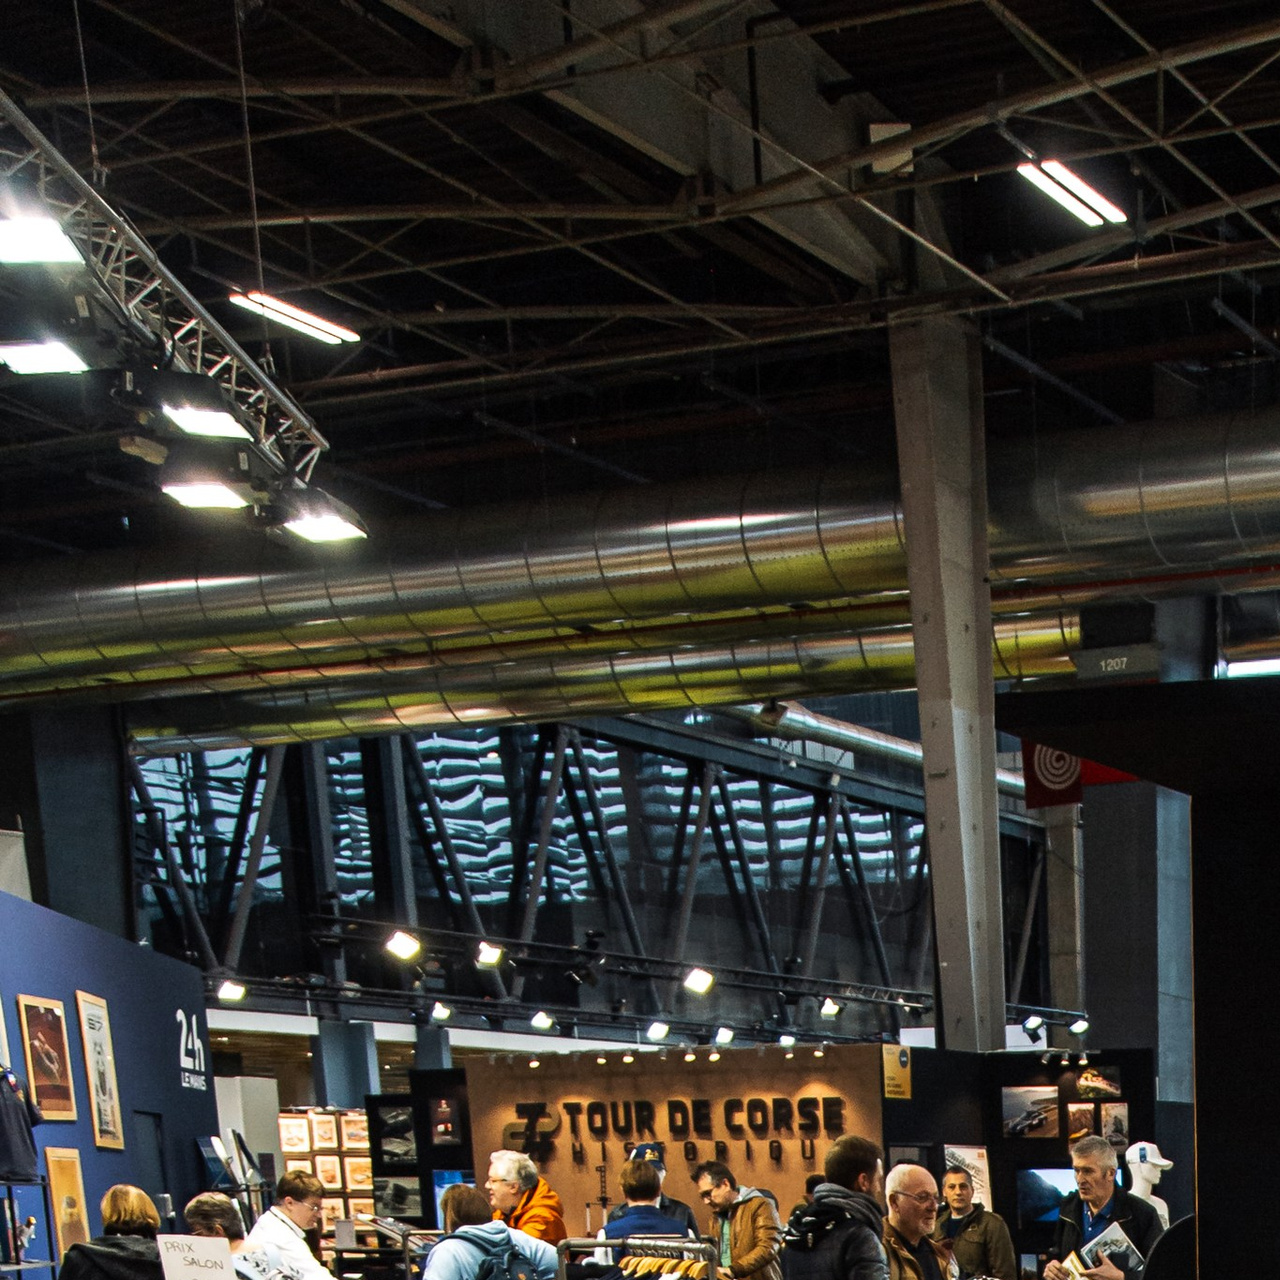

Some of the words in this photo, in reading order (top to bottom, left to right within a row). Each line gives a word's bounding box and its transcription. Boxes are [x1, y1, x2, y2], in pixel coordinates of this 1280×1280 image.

[1100, 658, 1127, 671] 1207
[562, 1101, 654, 1136] TOUR
[668, 1099, 712, 1138] DE
[724, 1096, 845, 1137] CORSE
[164, 1241, 195, 1253] PRIX
[183, 1256, 224, 1270] SALON
